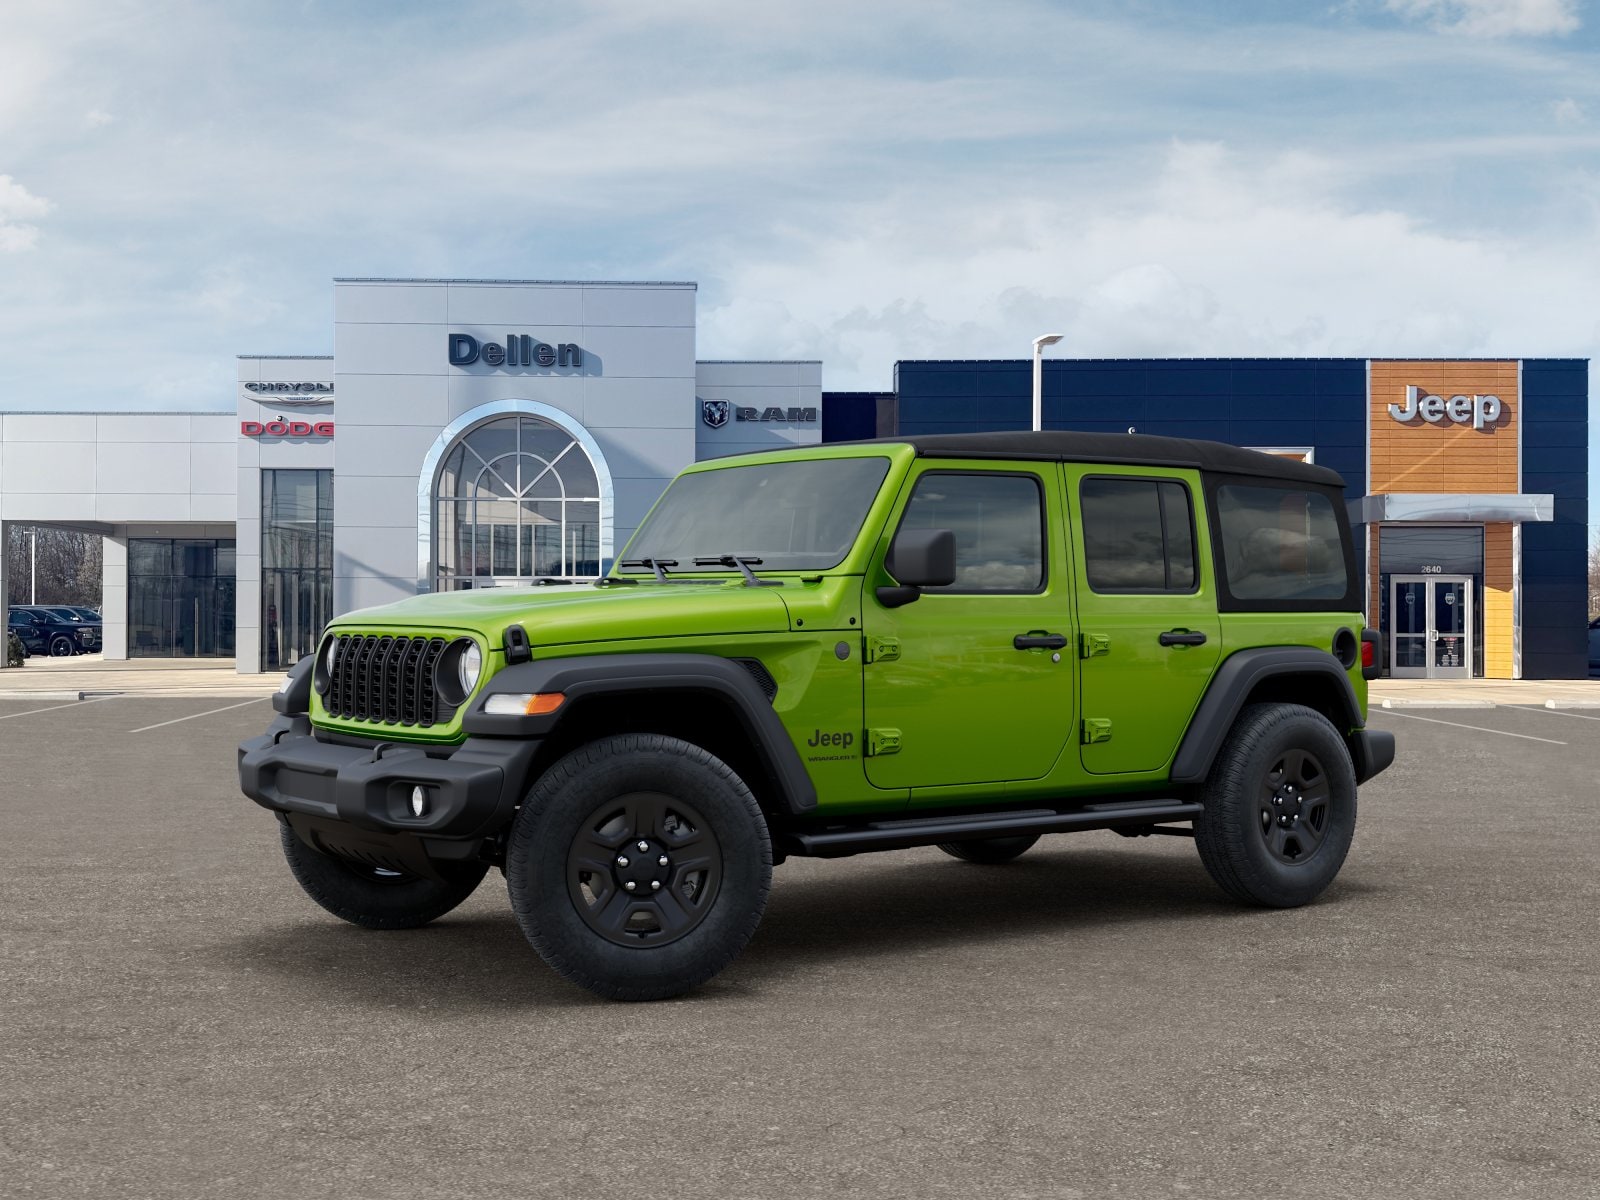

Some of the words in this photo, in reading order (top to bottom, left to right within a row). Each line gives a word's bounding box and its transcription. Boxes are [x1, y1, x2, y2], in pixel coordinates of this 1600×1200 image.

[449, 333, 582, 366] Dellen
[736, 407, 817, 421] RAM
[1387, 384, 1501, 429] Jeep
[241, 422, 334, 436] DODG
[1421, 565, 1442, 573] 2640
[808, 729, 854, 749] Jeep
